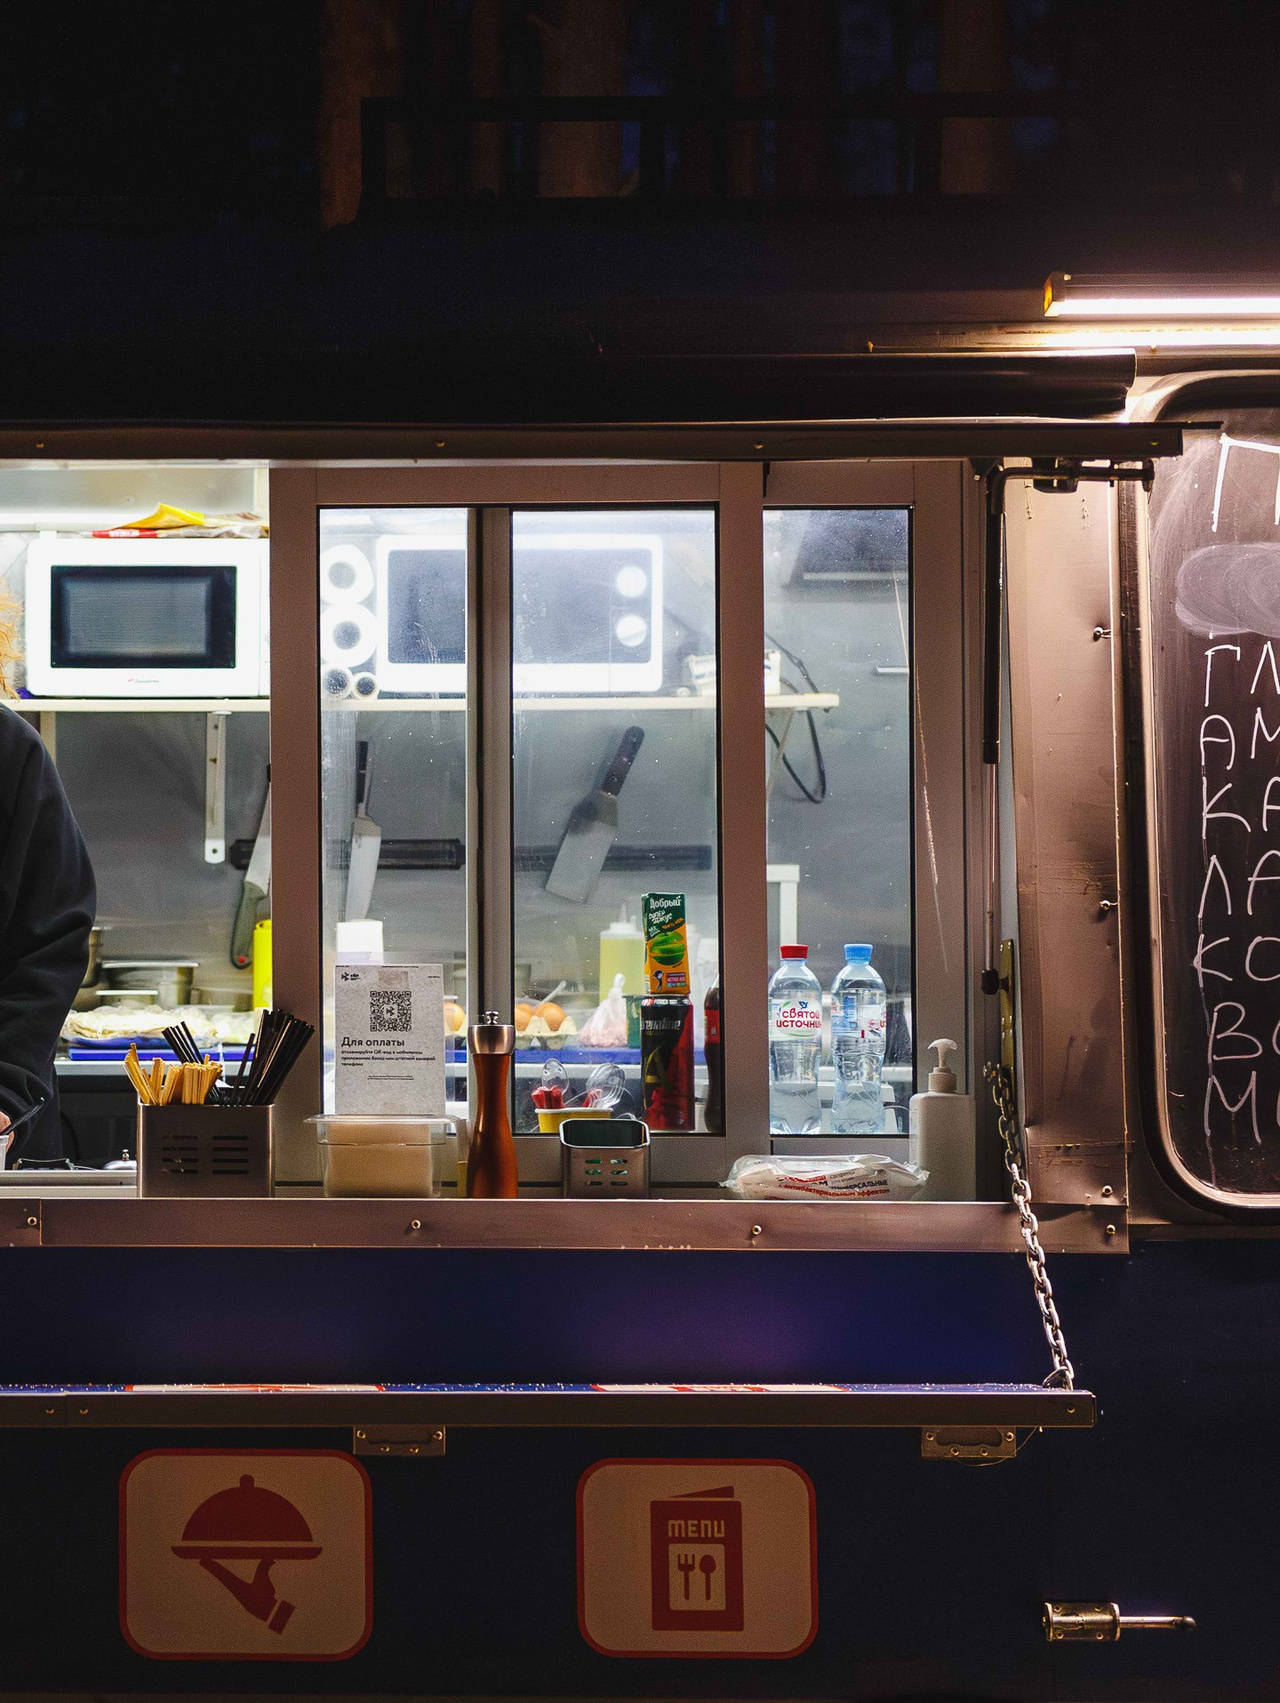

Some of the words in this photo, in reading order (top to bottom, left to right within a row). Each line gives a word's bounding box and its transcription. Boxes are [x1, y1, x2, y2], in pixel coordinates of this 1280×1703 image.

[650, 895, 682, 909] Добрый
[341, 1037, 363, 1047] Для
[365, 1039, 405, 1047] оплаты
[667, 1519, 725, 1538] MENU
